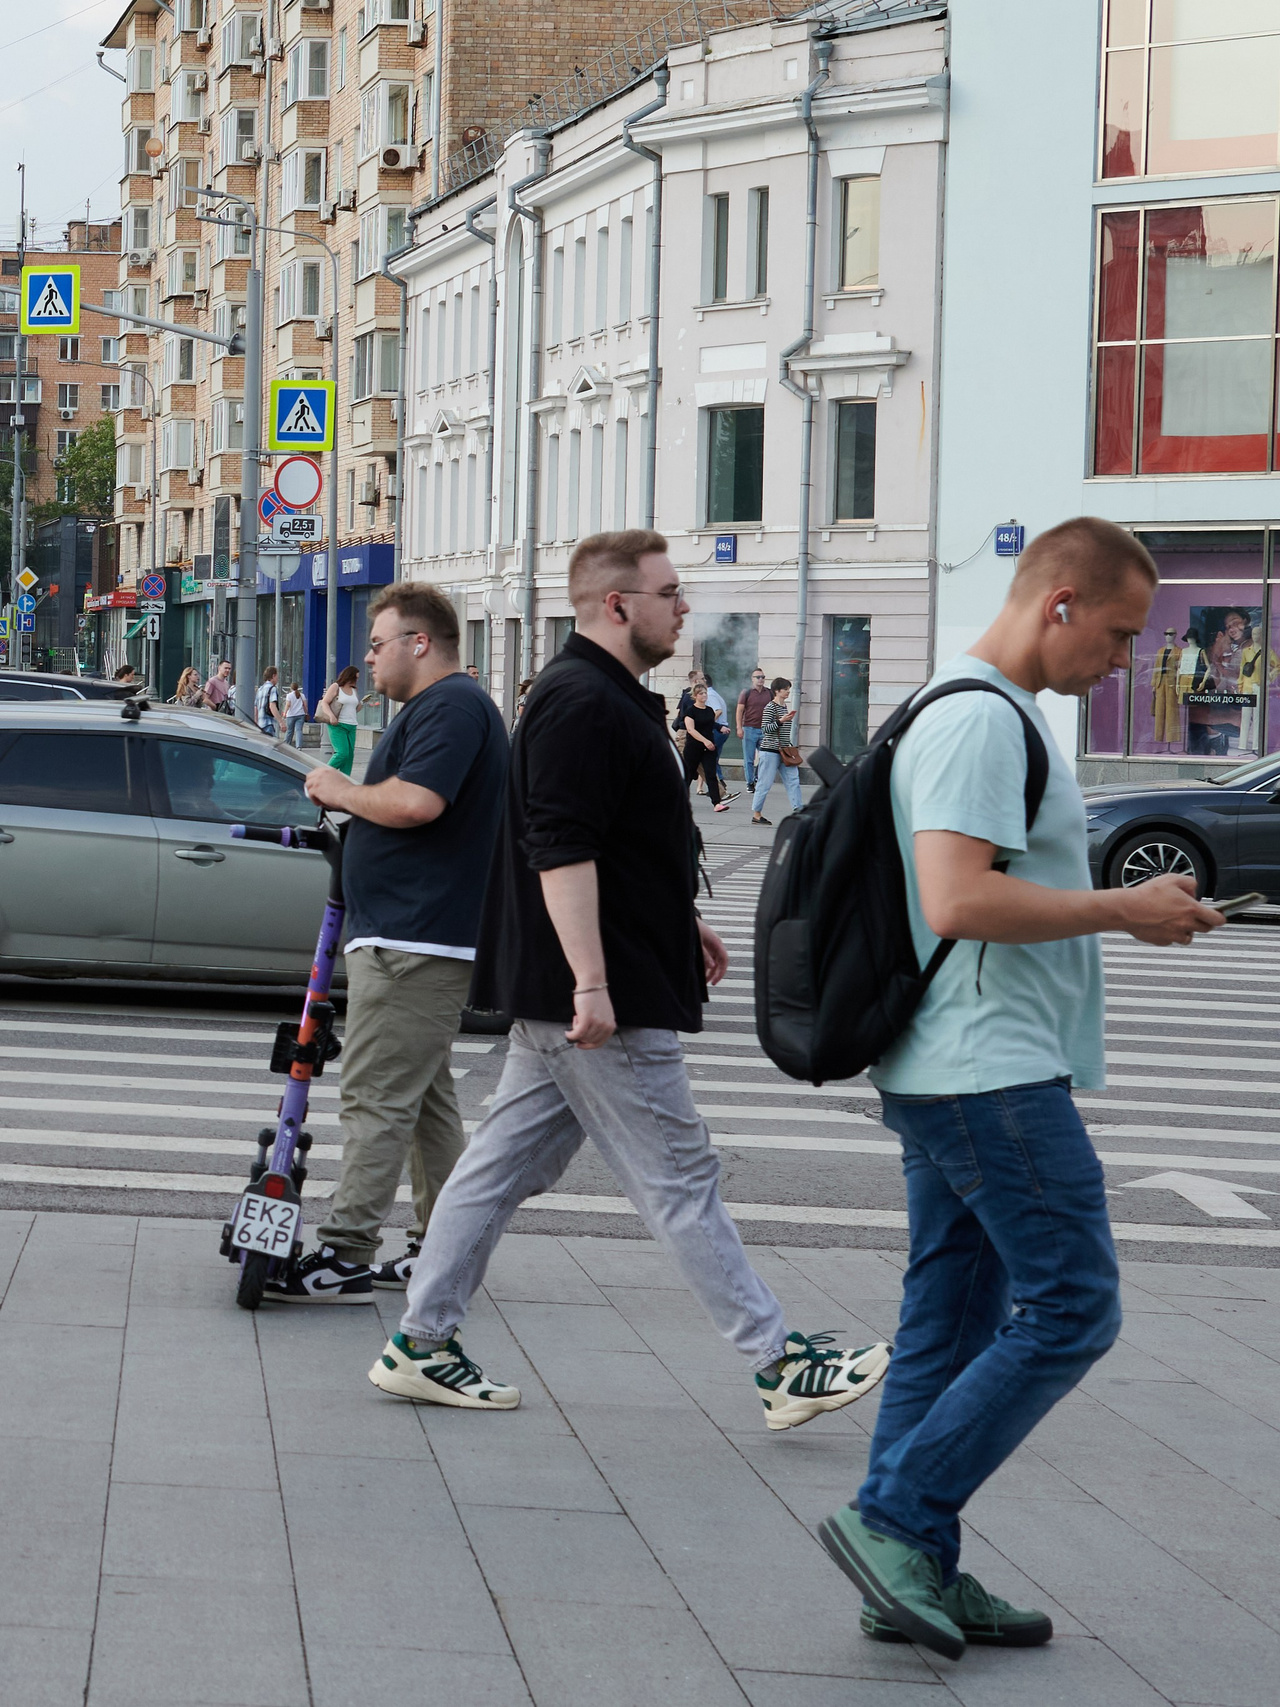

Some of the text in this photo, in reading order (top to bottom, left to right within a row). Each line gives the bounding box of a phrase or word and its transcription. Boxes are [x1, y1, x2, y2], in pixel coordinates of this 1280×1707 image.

[717, 542, 731, 552] 48/2
[1188, 695, 1221, 703] СКИДКИ
[1222, 696, 1234, 704] ДО
